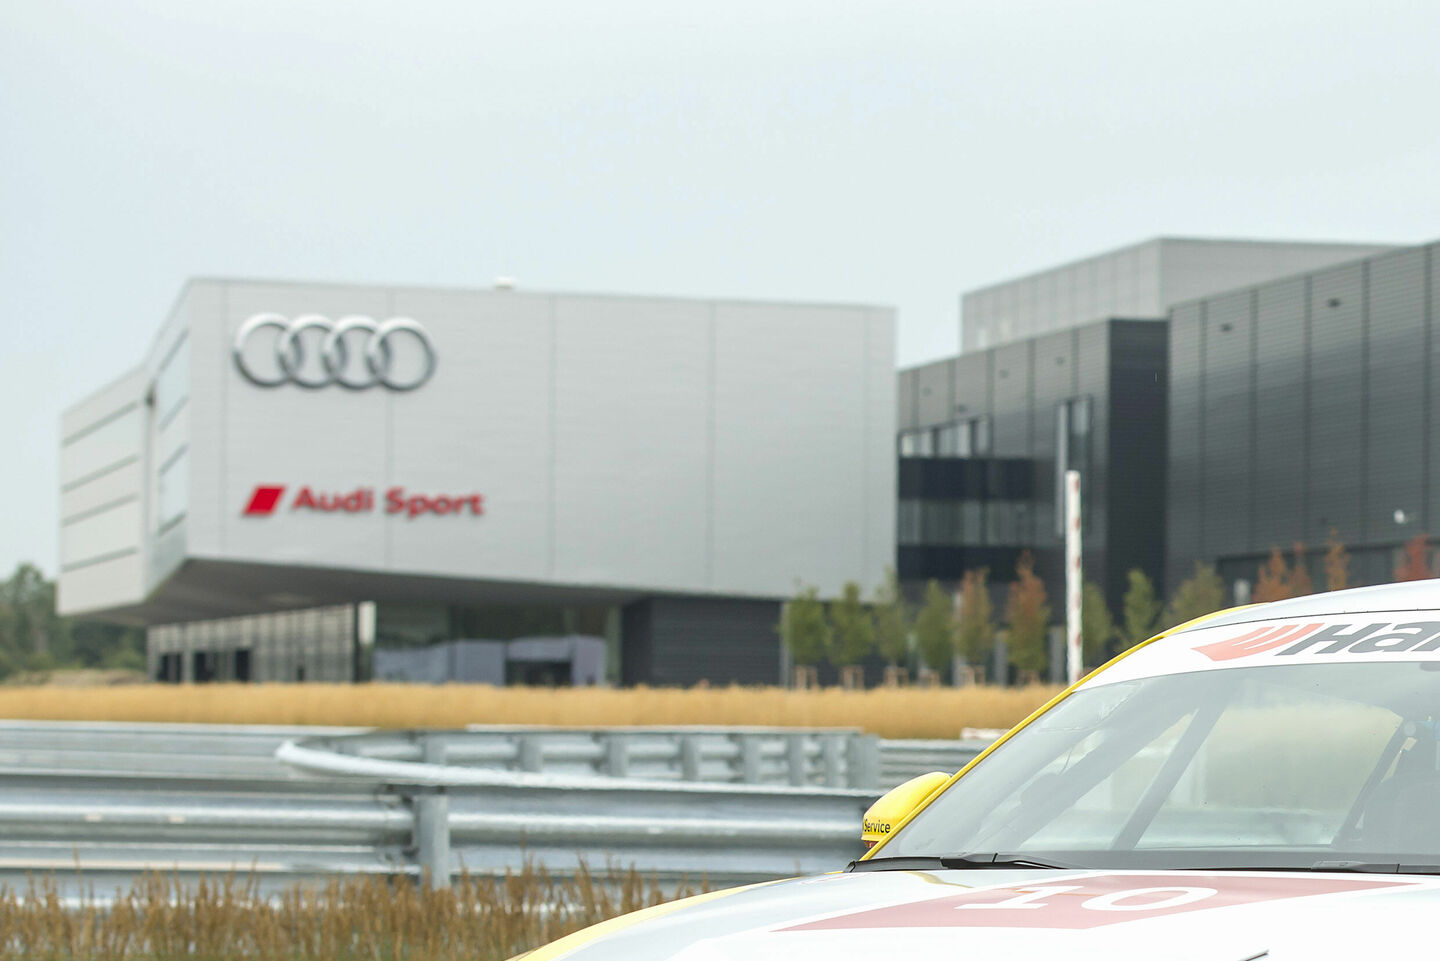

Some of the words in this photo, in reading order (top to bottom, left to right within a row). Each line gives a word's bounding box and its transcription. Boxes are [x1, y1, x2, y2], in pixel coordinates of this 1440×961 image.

[292, 485, 374, 511] Audi
[385, 487, 485, 520] Sport
[864, 819, 891, 833] Service
[955, 885, 1218, 911] 10
